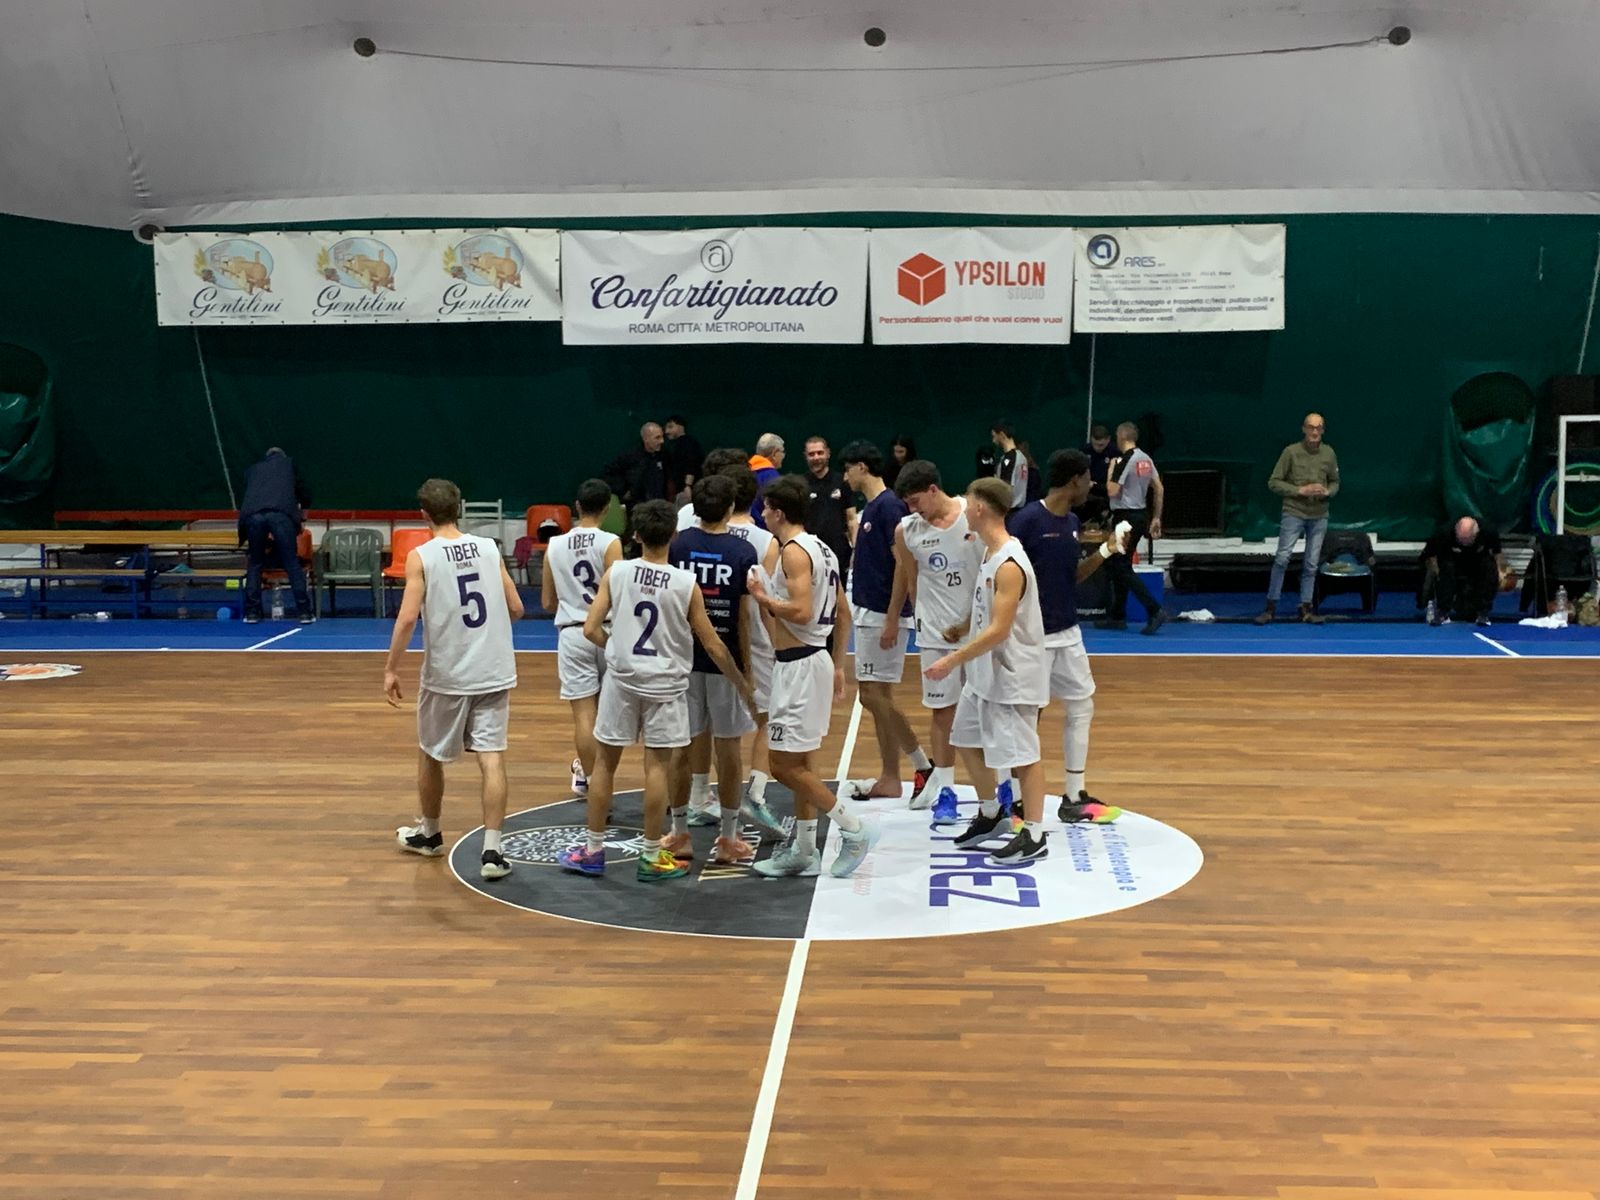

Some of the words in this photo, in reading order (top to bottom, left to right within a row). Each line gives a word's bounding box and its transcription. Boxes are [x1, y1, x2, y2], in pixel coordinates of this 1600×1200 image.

[1123, 256, 1157, 268] ARES
[954, 261, 1046, 286] YPSILON
[189, 286, 284, 318] Gentilini
[312, 284, 407, 317] Gentilini
[438, 282, 534, 315] Gentilini
[590, 273, 838, 320] Confartigianato
[1007, 288, 1045, 300] STUDIO
[628, 323, 665, 334] ROMA
[705, 321, 805, 333] METROPOLITANA
[442, 542, 480, 562] TIBER
[456, 561, 473, 569] ROMA
[573, 559, 599, 605] 3
[634, 565, 671, 589] TIBER
[945, 572, 962, 587] 25
[457, 572, 488, 629] 5
[640, 586, 656, 596] ROMA
[632, 600, 658, 657] 2
[863, 663, 874, 675] 11
[770, 726, 784, 742] 22
